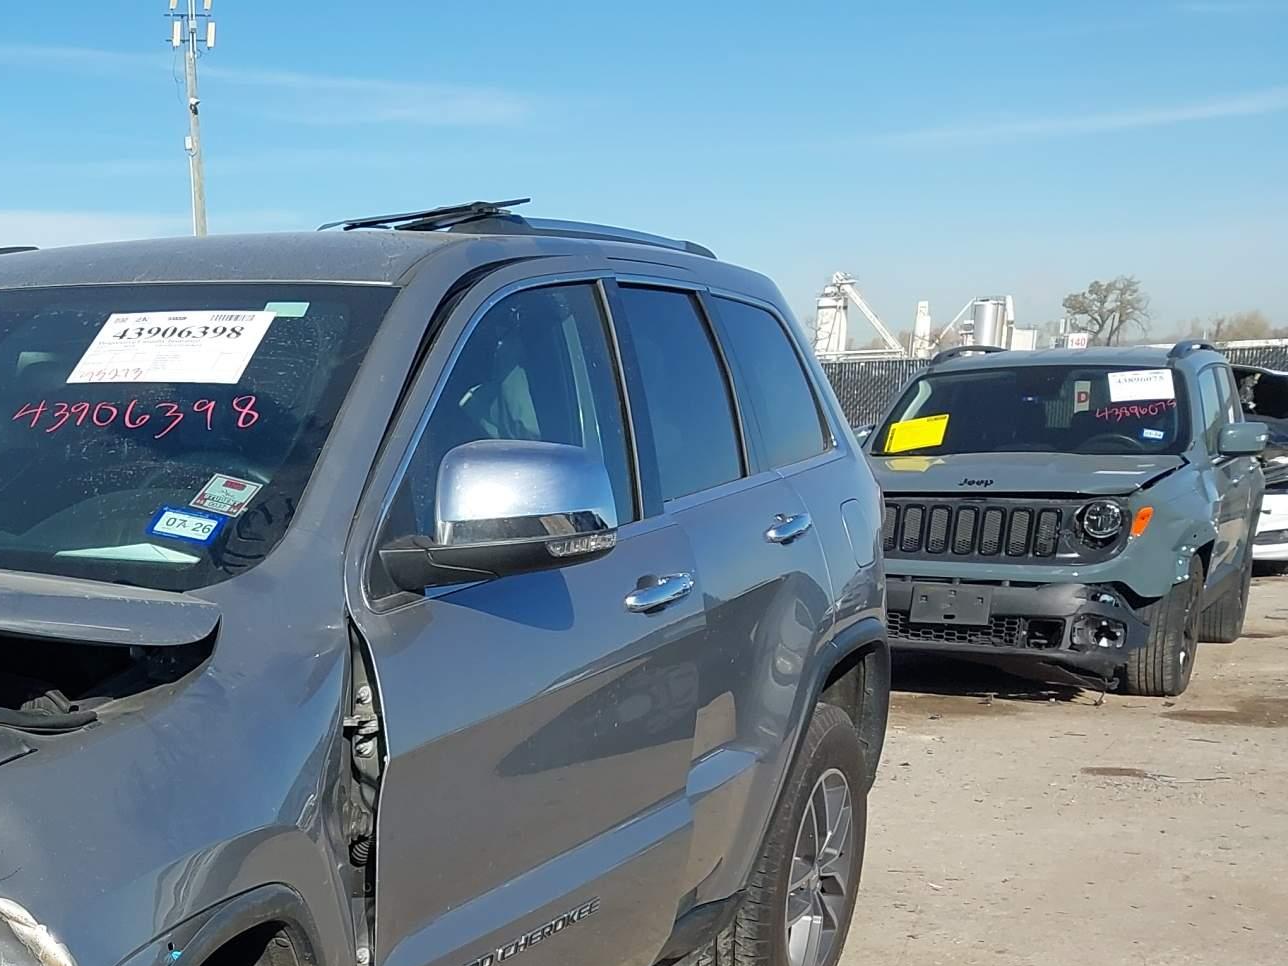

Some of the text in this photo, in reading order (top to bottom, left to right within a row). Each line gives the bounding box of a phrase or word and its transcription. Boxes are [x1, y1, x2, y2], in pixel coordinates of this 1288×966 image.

[112, 325, 245, 340] 43906398
[12, 395, 260, 439] 43906398
[1095, 399, 1177, 423] 43896075
[957, 478, 994, 488] Jeep
[165, 517, 213, 534] 07 26
[495, 895, 601, 962] CHEROKEE
